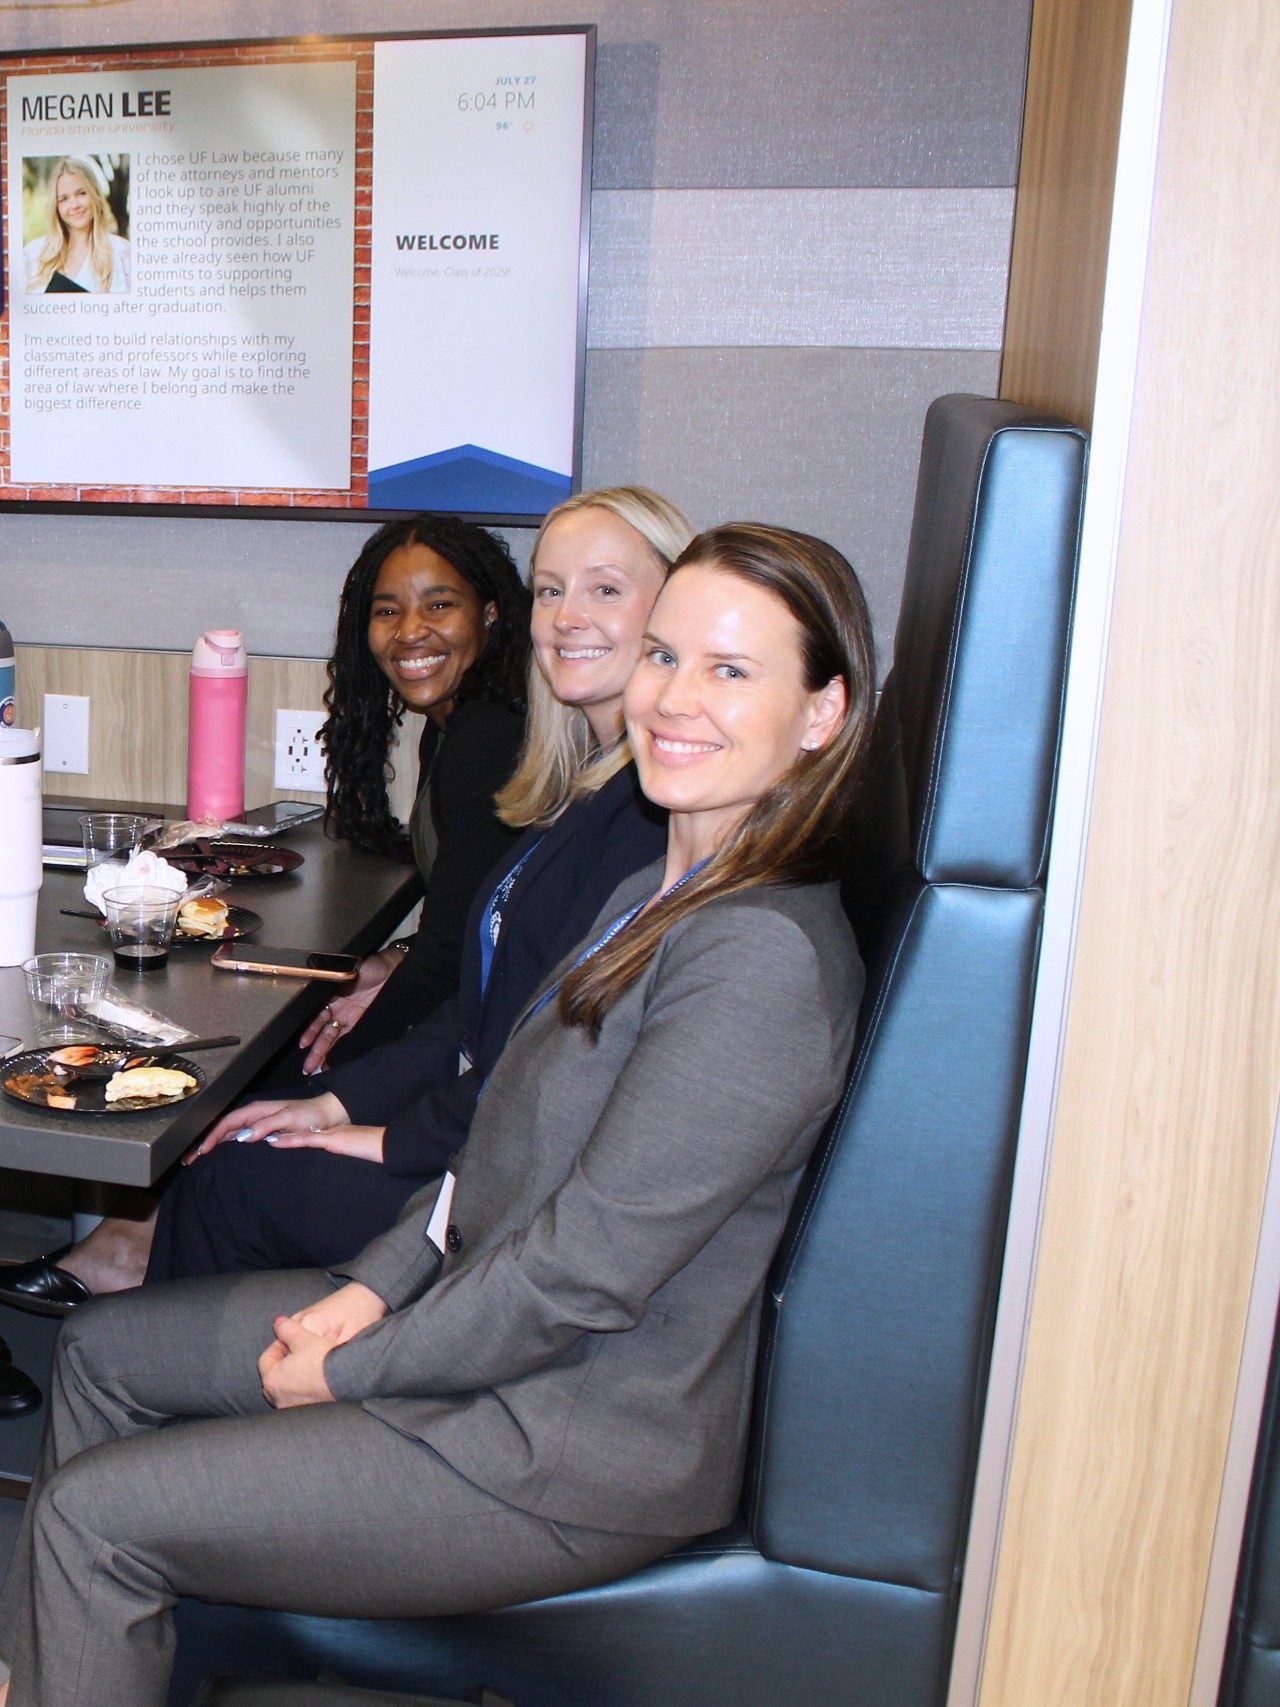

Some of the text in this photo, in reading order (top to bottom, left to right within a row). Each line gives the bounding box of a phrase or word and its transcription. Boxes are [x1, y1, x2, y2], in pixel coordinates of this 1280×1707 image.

[495, 76, 537, 85] JULY 27
[21, 89, 171, 121] MEGAN LEE
[458, 91, 535, 111] 6:04 PM
[136, 148, 343, 166] I chose UF Law because many
[136, 163, 338, 184] of the attorneys and mentors
[135, 181, 313, 201] I look up to are UF alumni
[136, 198, 330, 217] and they speak highly of the
[136, 214, 340, 234] community and opportunities
[136, 231, 314, 249] the school provides. I also
[396, 235, 500, 250] WELCOME
[137, 248, 313, 266] have already seen how UF
[136, 266, 292, 282] commits to supporting
[394, 266, 511, 278] Welcome, Class of 2029!
[137, 282, 305, 299] students and helps them
[24, 299, 225, 316] succeed long after graduation.
[46, 333, 91, 346] excited
[96, 335, 109, 346] to
[113, 333, 145, 346] build
[150, 332, 237, 348] relationships
[240, 332, 269, 345] with
[273, 335, 294, 348] my
[24, 348, 305, 364] classmates and professors while exploring
[24, 365, 310, 380] different areas of law. My goal is to find the
[23, 381, 295, 396] area of law where I belong and make the
[24, 396, 143, 411] biggest difference.
